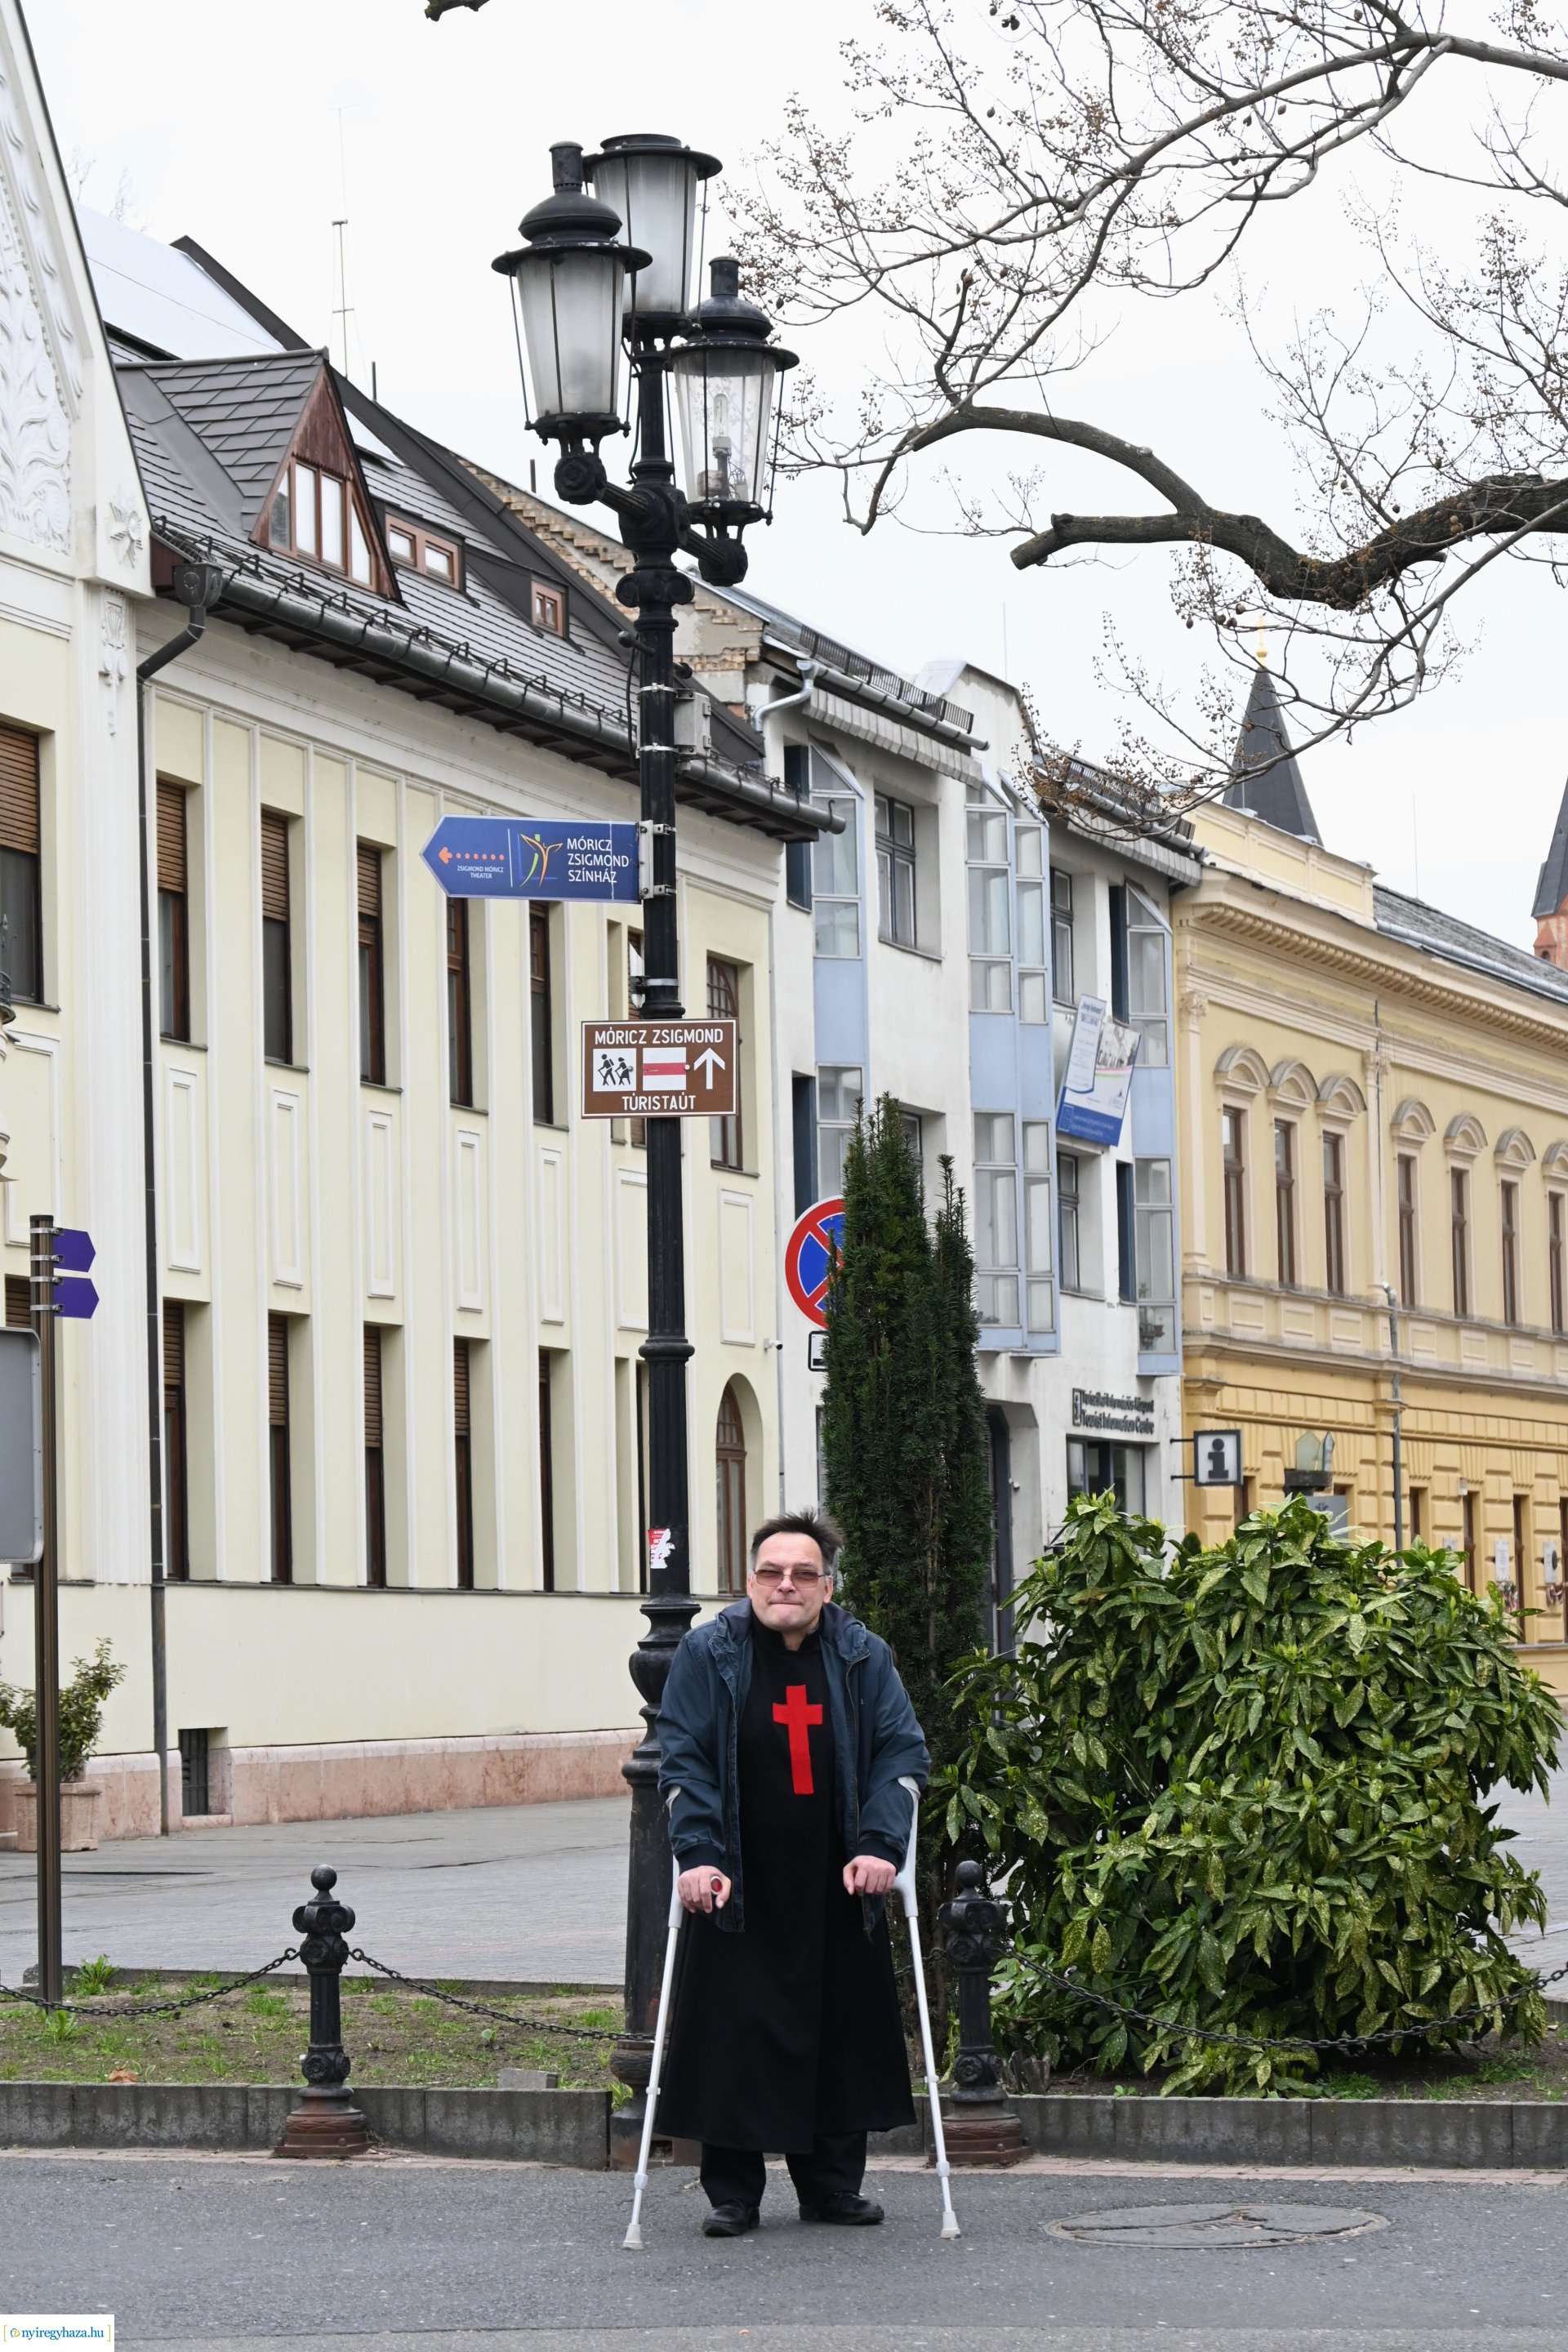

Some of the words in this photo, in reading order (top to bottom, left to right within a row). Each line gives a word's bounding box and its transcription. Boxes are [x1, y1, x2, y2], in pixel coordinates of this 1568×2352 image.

[567, 835, 612, 851] MÓRICZ
[568, 853, 630, 867] ZSIGMOND
[568, 867, 617, 884] SZÍNHÁZ
[595, 1027, 647, 1045] MÓRICZ
[653, 1028, 724, 1044] ZSIGMOND
